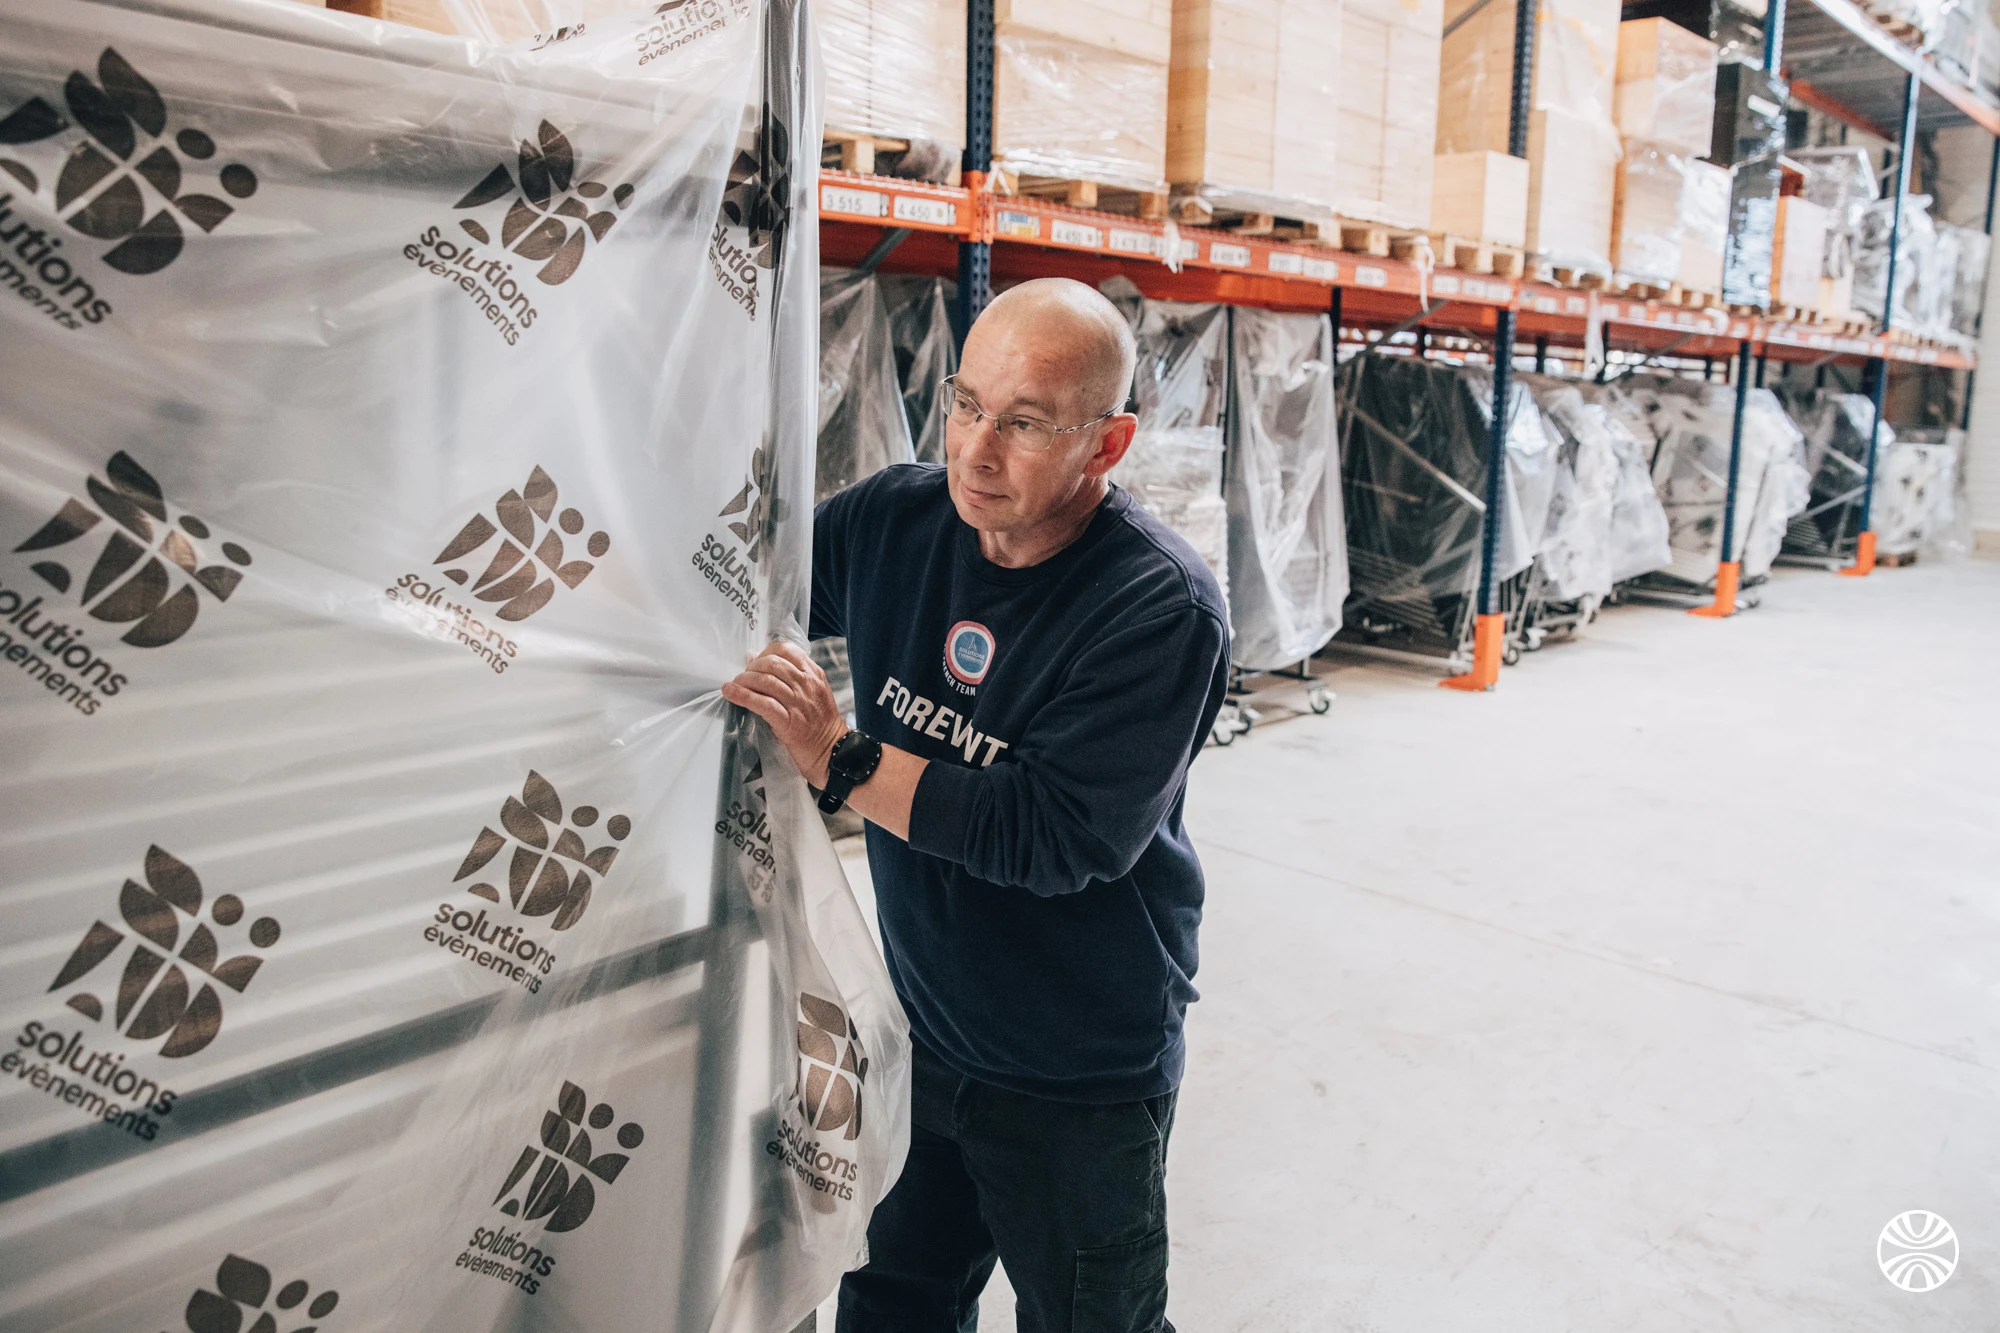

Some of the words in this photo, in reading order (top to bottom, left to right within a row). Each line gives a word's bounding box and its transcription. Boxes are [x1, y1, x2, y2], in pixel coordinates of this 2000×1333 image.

[635, 0, 746, 51] solutio
[403, 243, 520, 346] évènements
[420, 225, 538, 329] solutions
[0, 589, 128, 697] olutions
[955, 682, 976, 697] TEAM
[726, 801, 772, 845] solu
[424, 924, 542, 994] évènements
[434, 903, 556, 975] solutions
[0, 1050, 161, 1142] évènements
[17, 1020, 179, 1116] solutions
[778, 1119, 858, 1182] solutions
[469, 1226, 556, 1277] solutions
